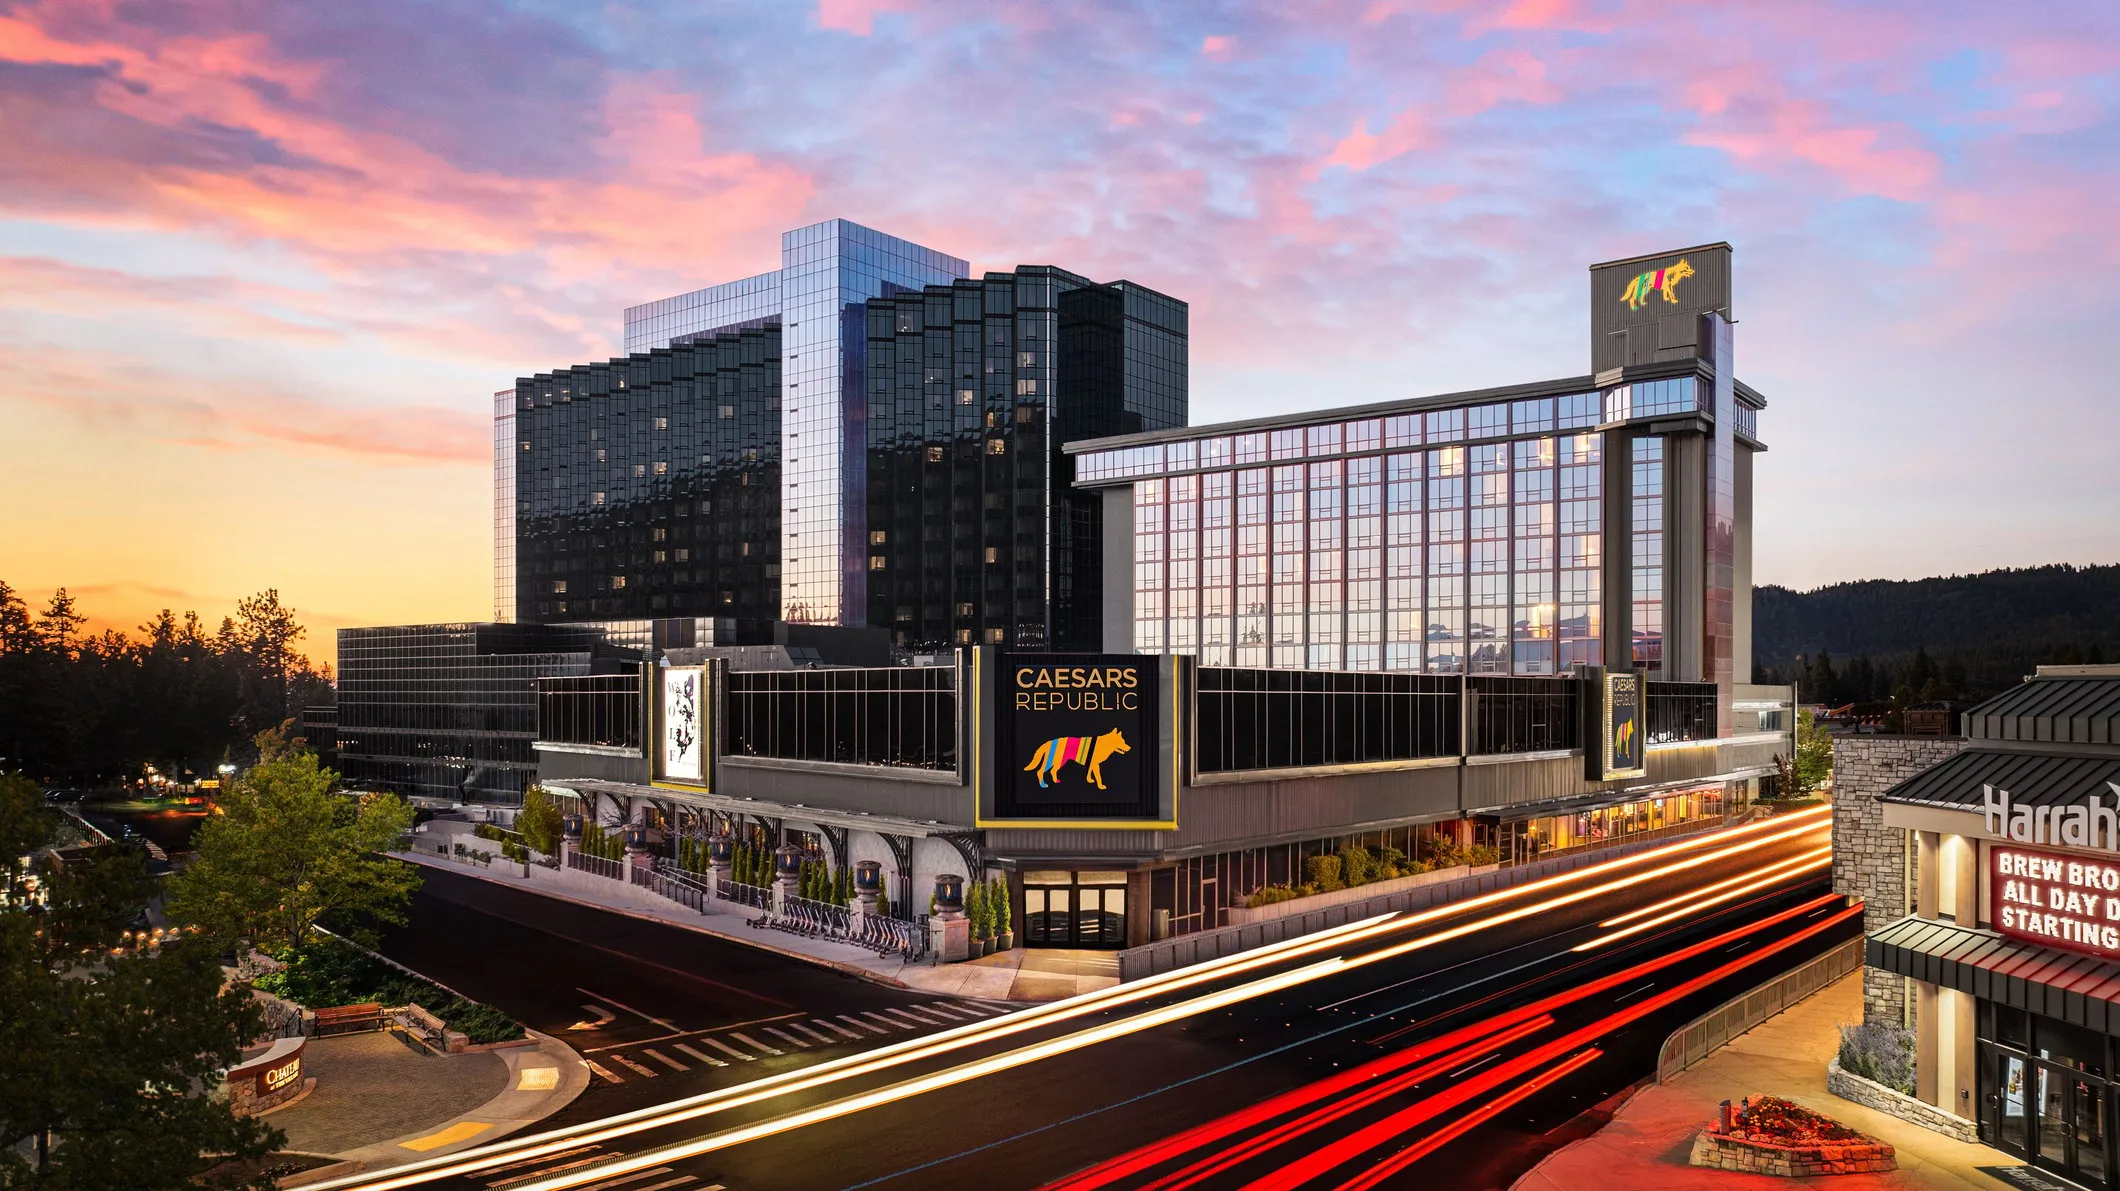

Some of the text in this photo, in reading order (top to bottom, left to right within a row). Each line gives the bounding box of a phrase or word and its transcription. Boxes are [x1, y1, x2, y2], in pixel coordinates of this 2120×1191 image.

[1016, 668, 1138, 689] CAESARS
[1614, 678, 1635, 692] CAESARS
[1016, 692, 1138, 711] REPUBLIC
[1983, 783, 2120, 852] Harrah
[1999, 852, 2064, 883] BREW
[2003, 880, 2044, 907] ALL
[2050, 887, 2101, 917] DAY
[2002, 905, 2119, 950] STARTING
